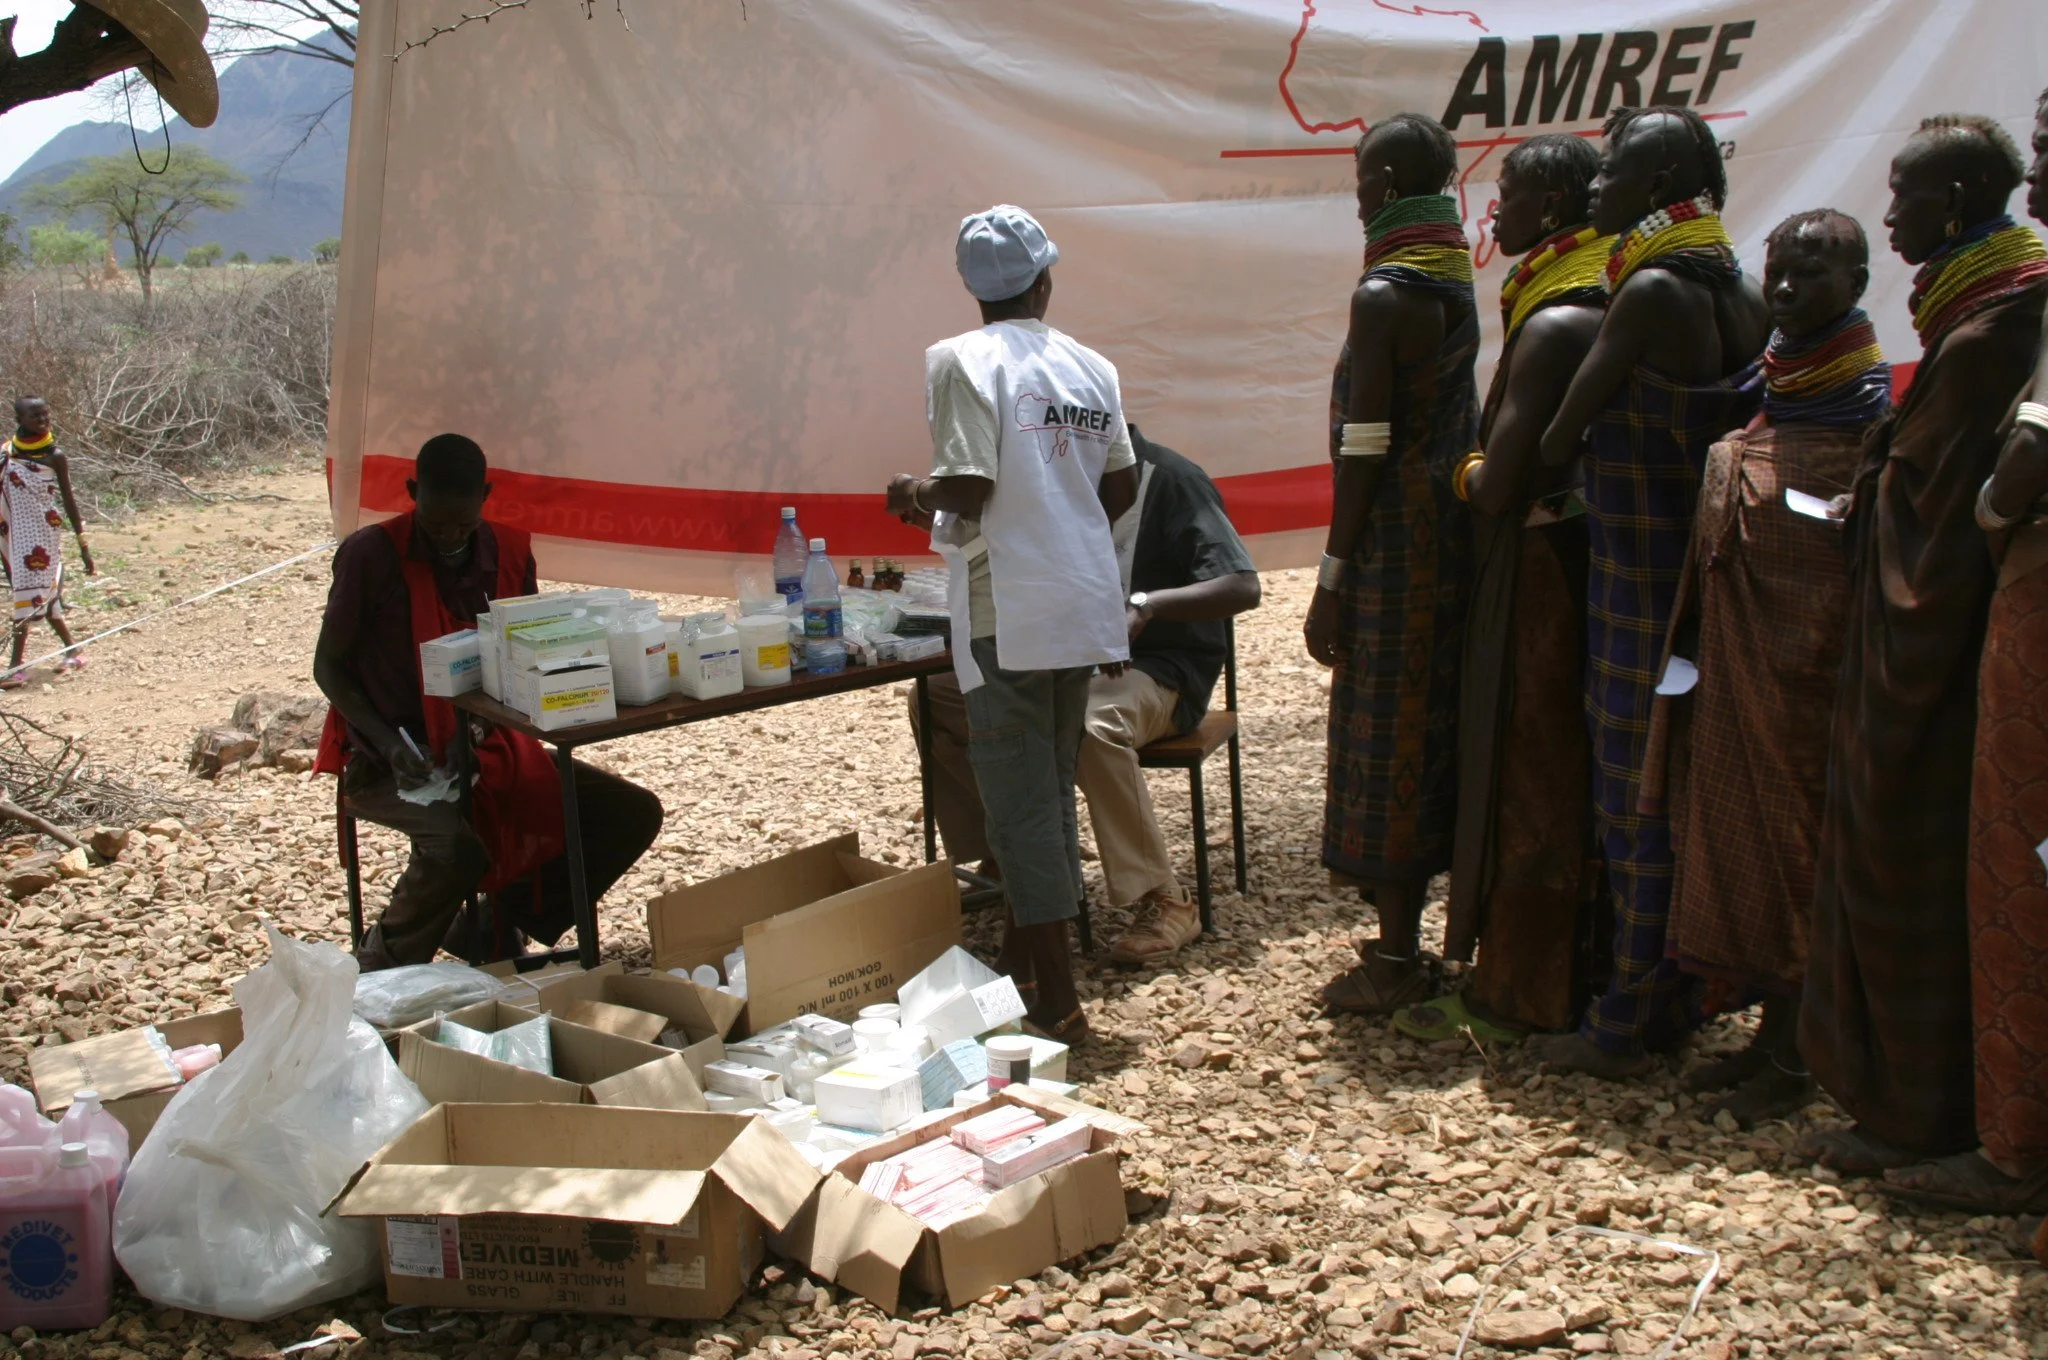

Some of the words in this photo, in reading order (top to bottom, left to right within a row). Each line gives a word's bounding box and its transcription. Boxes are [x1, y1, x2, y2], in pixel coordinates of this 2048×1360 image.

[1441, 19, 1757, 132] AMREF
[1045, 405, 1112, 432] AMREF
[827, 961, 882, 988] GOK/MOH
[874, 973, 895, 990] 100
[839, 986, 860, 1002] 100
[1, 1220, 75, 1250] MEDIVET
[460, 1241, 579, 1268] MEDIVET
[1, 1268, 78, 1302] PRODUCTS
[463, 1267, 509, 1282] CARE
[514, 1270, 555, 1285] WITH
[558, 1272, 625, 1289] HANDLE
[466, 1283, 521, 1300] GLASS
